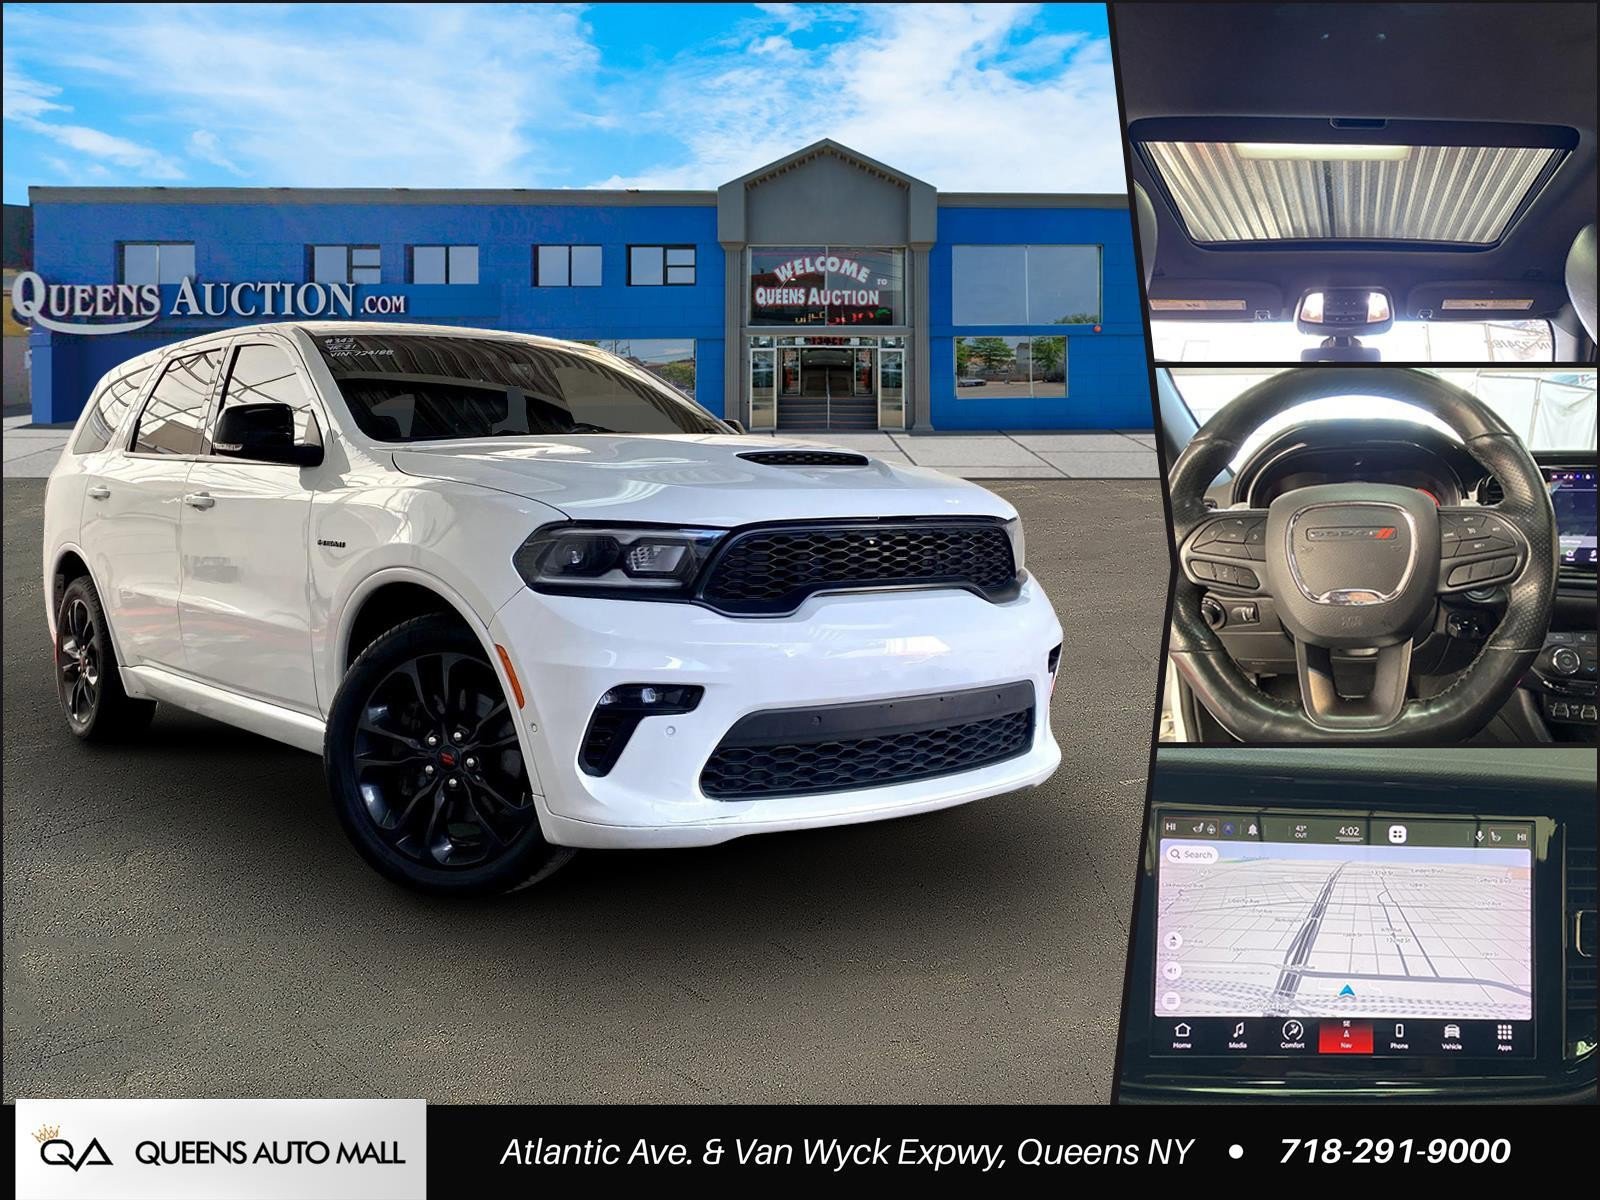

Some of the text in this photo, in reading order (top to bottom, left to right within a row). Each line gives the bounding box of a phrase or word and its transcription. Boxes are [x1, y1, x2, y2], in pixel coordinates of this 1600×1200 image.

[775, 256, 870, 283] WELCOME
[755, 287, 879, 306] QUEENS AUCTION
[12, 271, 161, 335] QUEENS
[1166, 823, 1176, 831] HI
[1339, 826, 1360, 837] 4:02
[1516, 833, 1527, 841] HI
[1184, 849, 1213, 859] Search
[1280, 1041, 1305, 1049] Comfort
[1390, 1042, 1409, 1050] Phone
